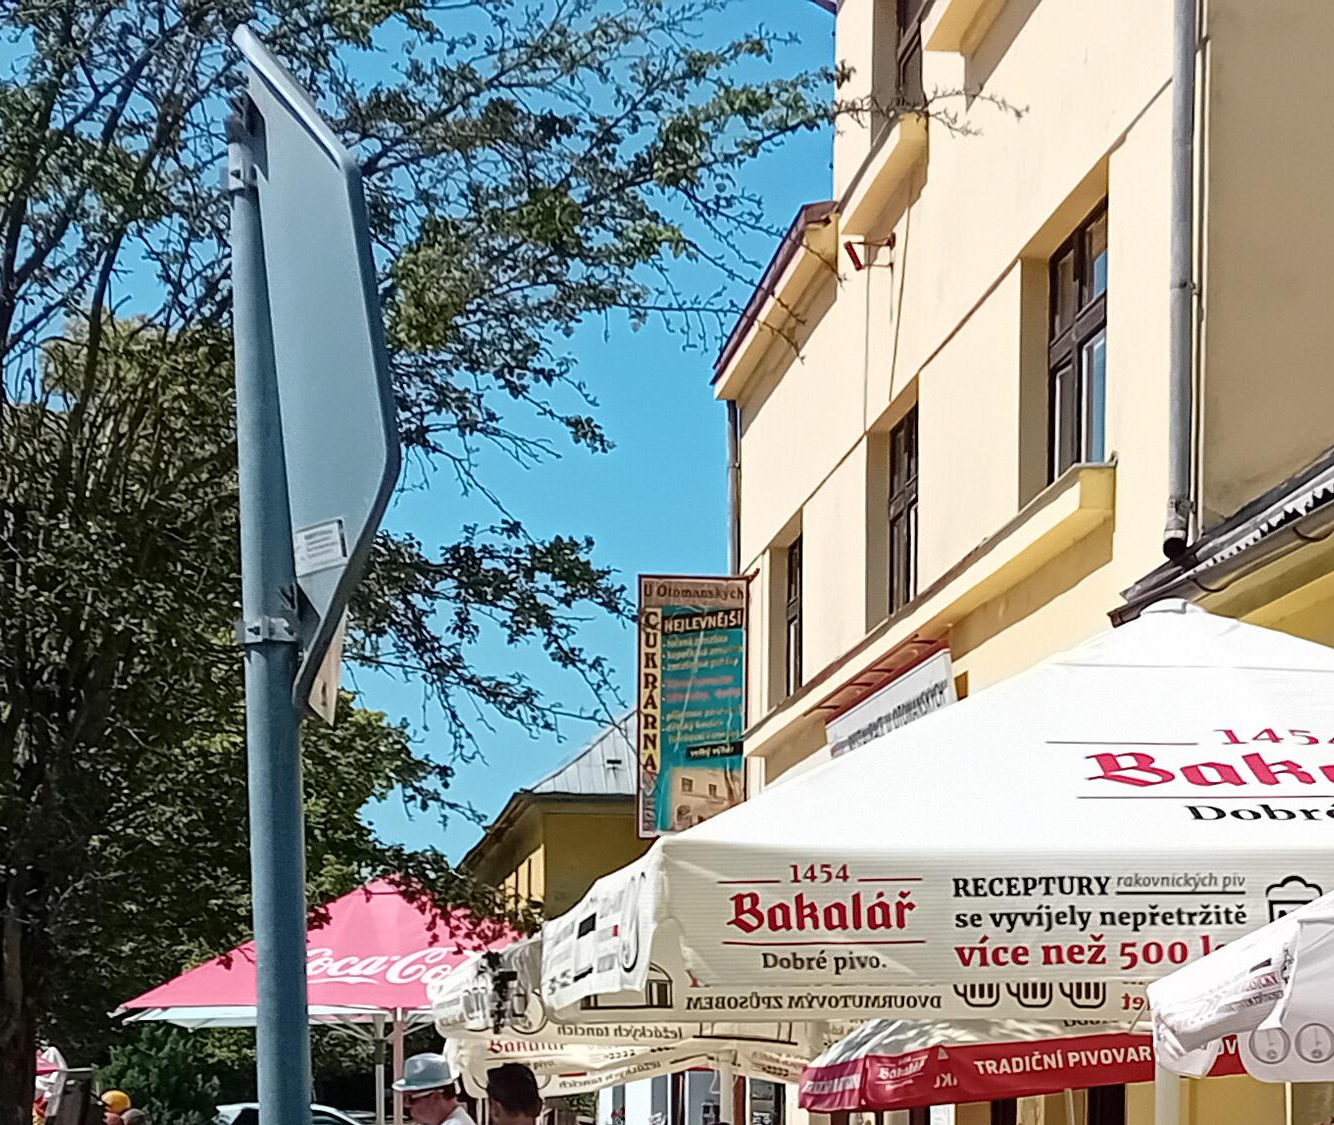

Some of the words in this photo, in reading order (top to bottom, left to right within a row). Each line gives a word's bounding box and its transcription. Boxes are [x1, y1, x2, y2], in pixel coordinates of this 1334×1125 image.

[643, 584, 653, 598] U
[643, 611, 659, 771] CUKRÁRNA
[789, 864, 850, 884] 1454
[953, 875, 1113, 898] RECEPTURY
[1116, 872, 1218, 893] rakovnických
[1221, 872, 1247, 889] piv
[726, 890, 917, 933] Bakalář
[955, 911, 984, 929] se
[989, 905, 1093, 934] vyvíjely
[1100, 904, 1248, 932] nepřetržitě
[762, 950, 827, 970] Dobré
[833, 950, 888, 976] pivo.
[954, 935, 1030, 968] více
[1041, 933, 1107, 966] než
[1118, 941, 1189, 971] 500
[973, 1050, 1065, 1076] TRADIČNÍ
[1068, 1045, 1153, 1069] PIVOVAR
